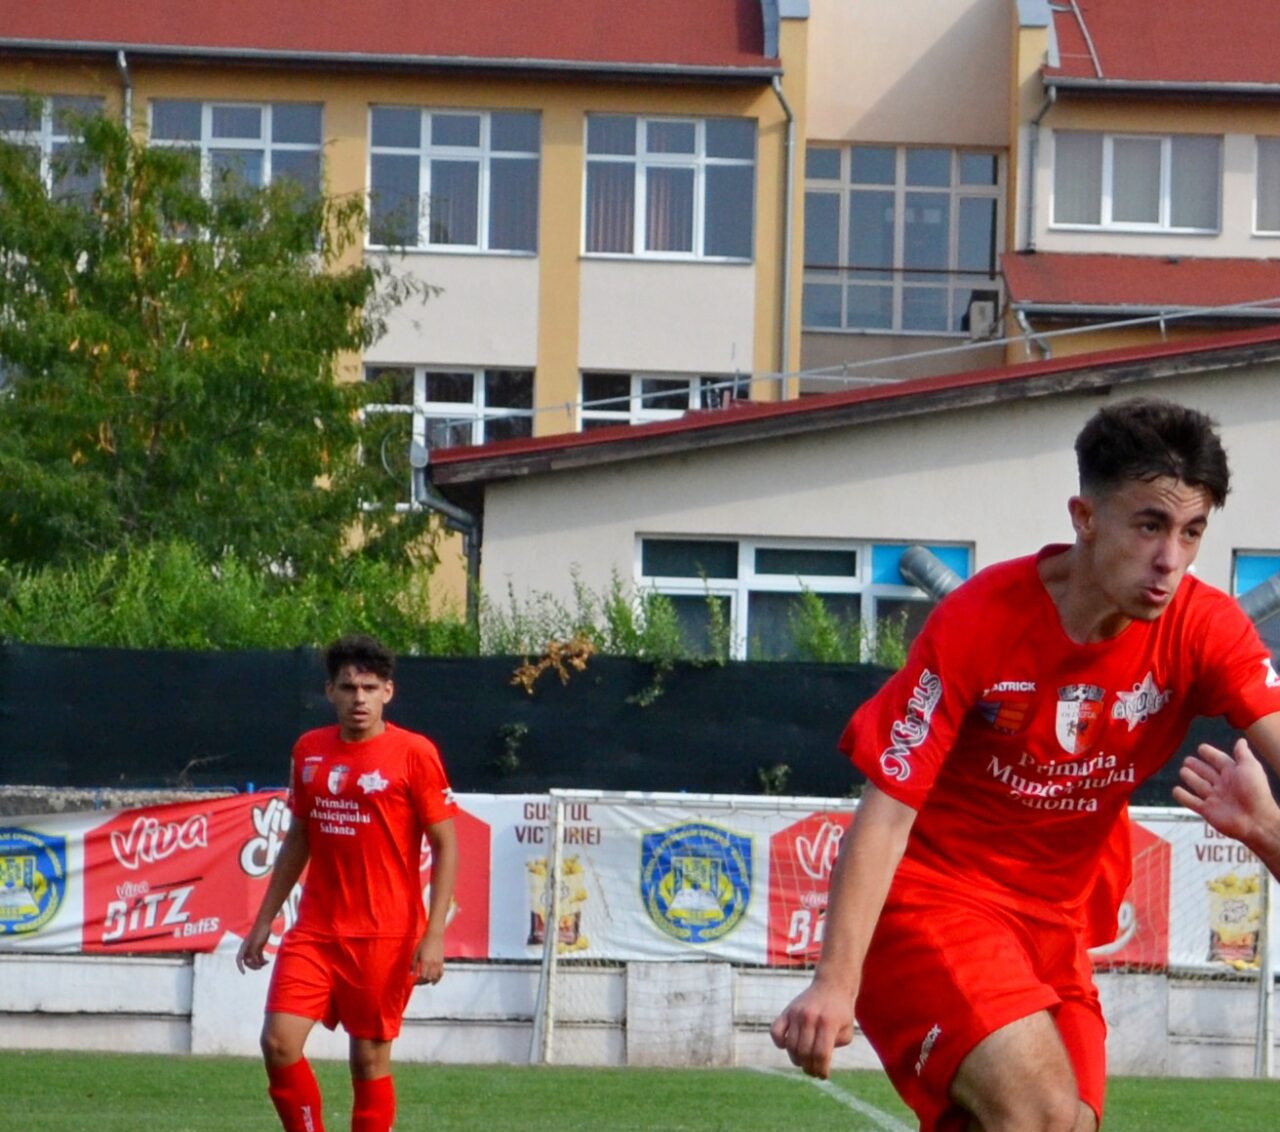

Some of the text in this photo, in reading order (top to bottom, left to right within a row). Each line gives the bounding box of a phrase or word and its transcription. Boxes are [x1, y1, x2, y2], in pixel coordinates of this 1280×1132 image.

[880, 668, 942, 781] Mirus
[252, 798, 292, 838] Vi
[320, 823, 356, 836] Salonta
[523, 802, 593, 821] GUTUL
[110, 815, 208, 870] Viva
[796, 822, 844, 880] Vi
